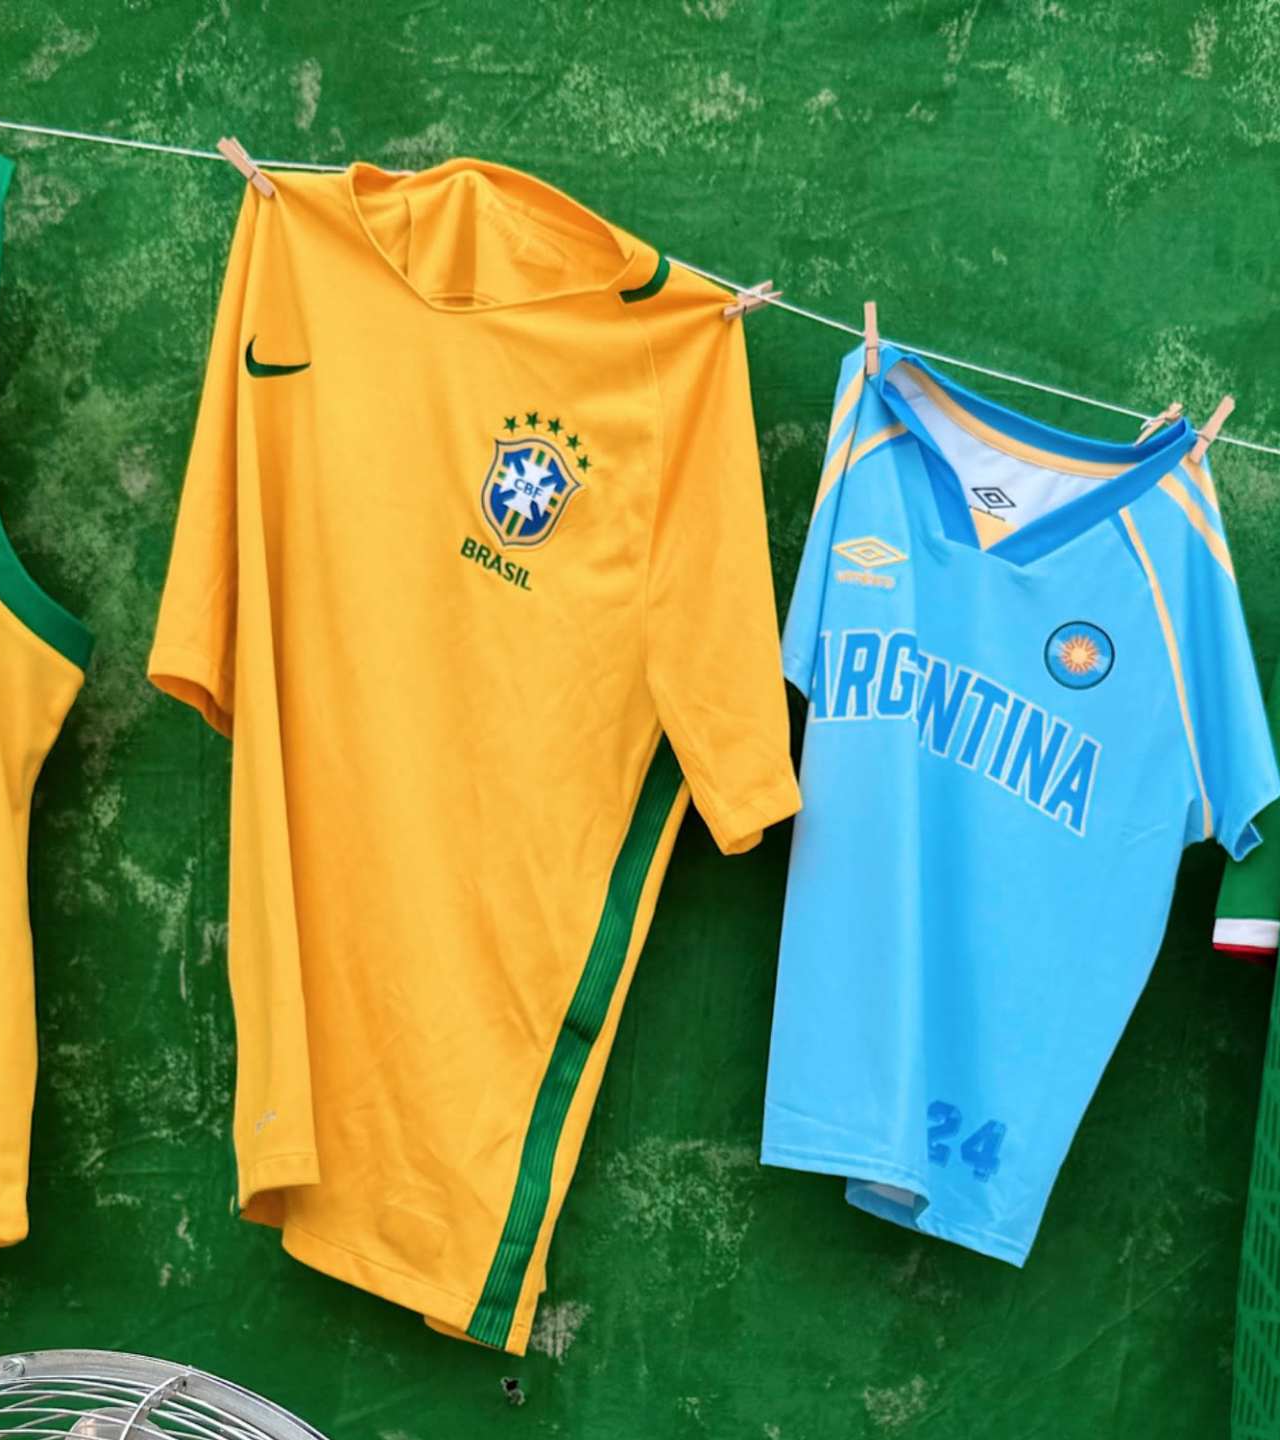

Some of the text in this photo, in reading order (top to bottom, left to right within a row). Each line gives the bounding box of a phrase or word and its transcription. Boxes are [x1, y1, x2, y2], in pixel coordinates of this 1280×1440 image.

[514, 478, 543, 499] CBF
[460, 537, 532, 591] BRASIL
[927, 1100, 1006, 1183] 24
